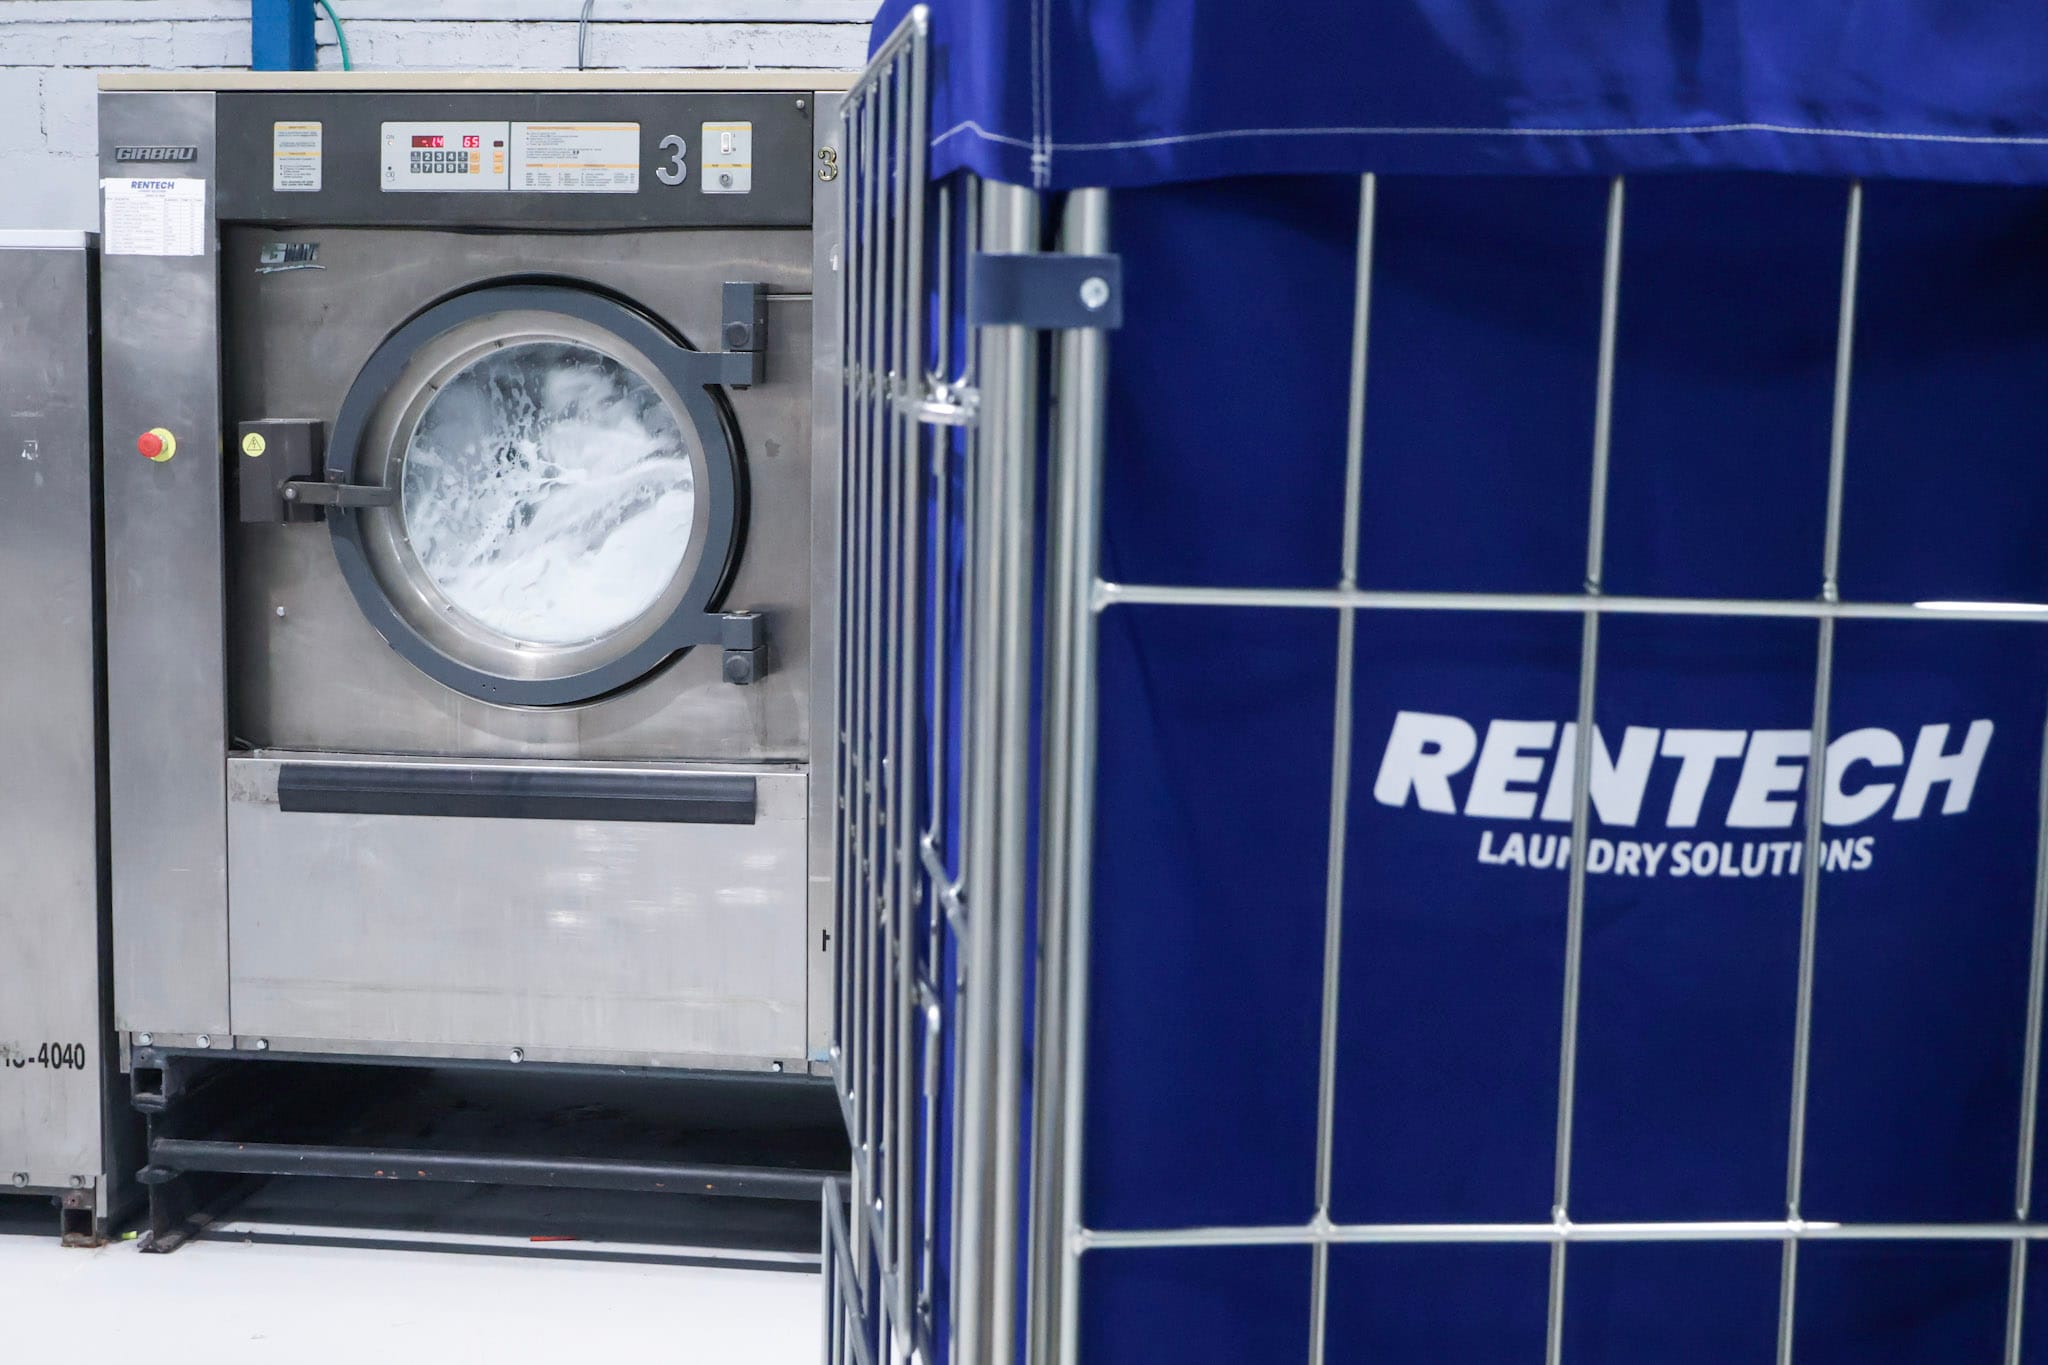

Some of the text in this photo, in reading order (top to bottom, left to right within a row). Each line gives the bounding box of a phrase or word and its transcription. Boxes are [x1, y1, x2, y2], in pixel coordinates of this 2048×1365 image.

[463, 136, 479, 147] 65
[656, 134, 687, 186] 3
[817, 146, 838, 181] 3
[131, 181, 175, 189] RENTECH
[1373, 710, 1994, 828] RENTECH
